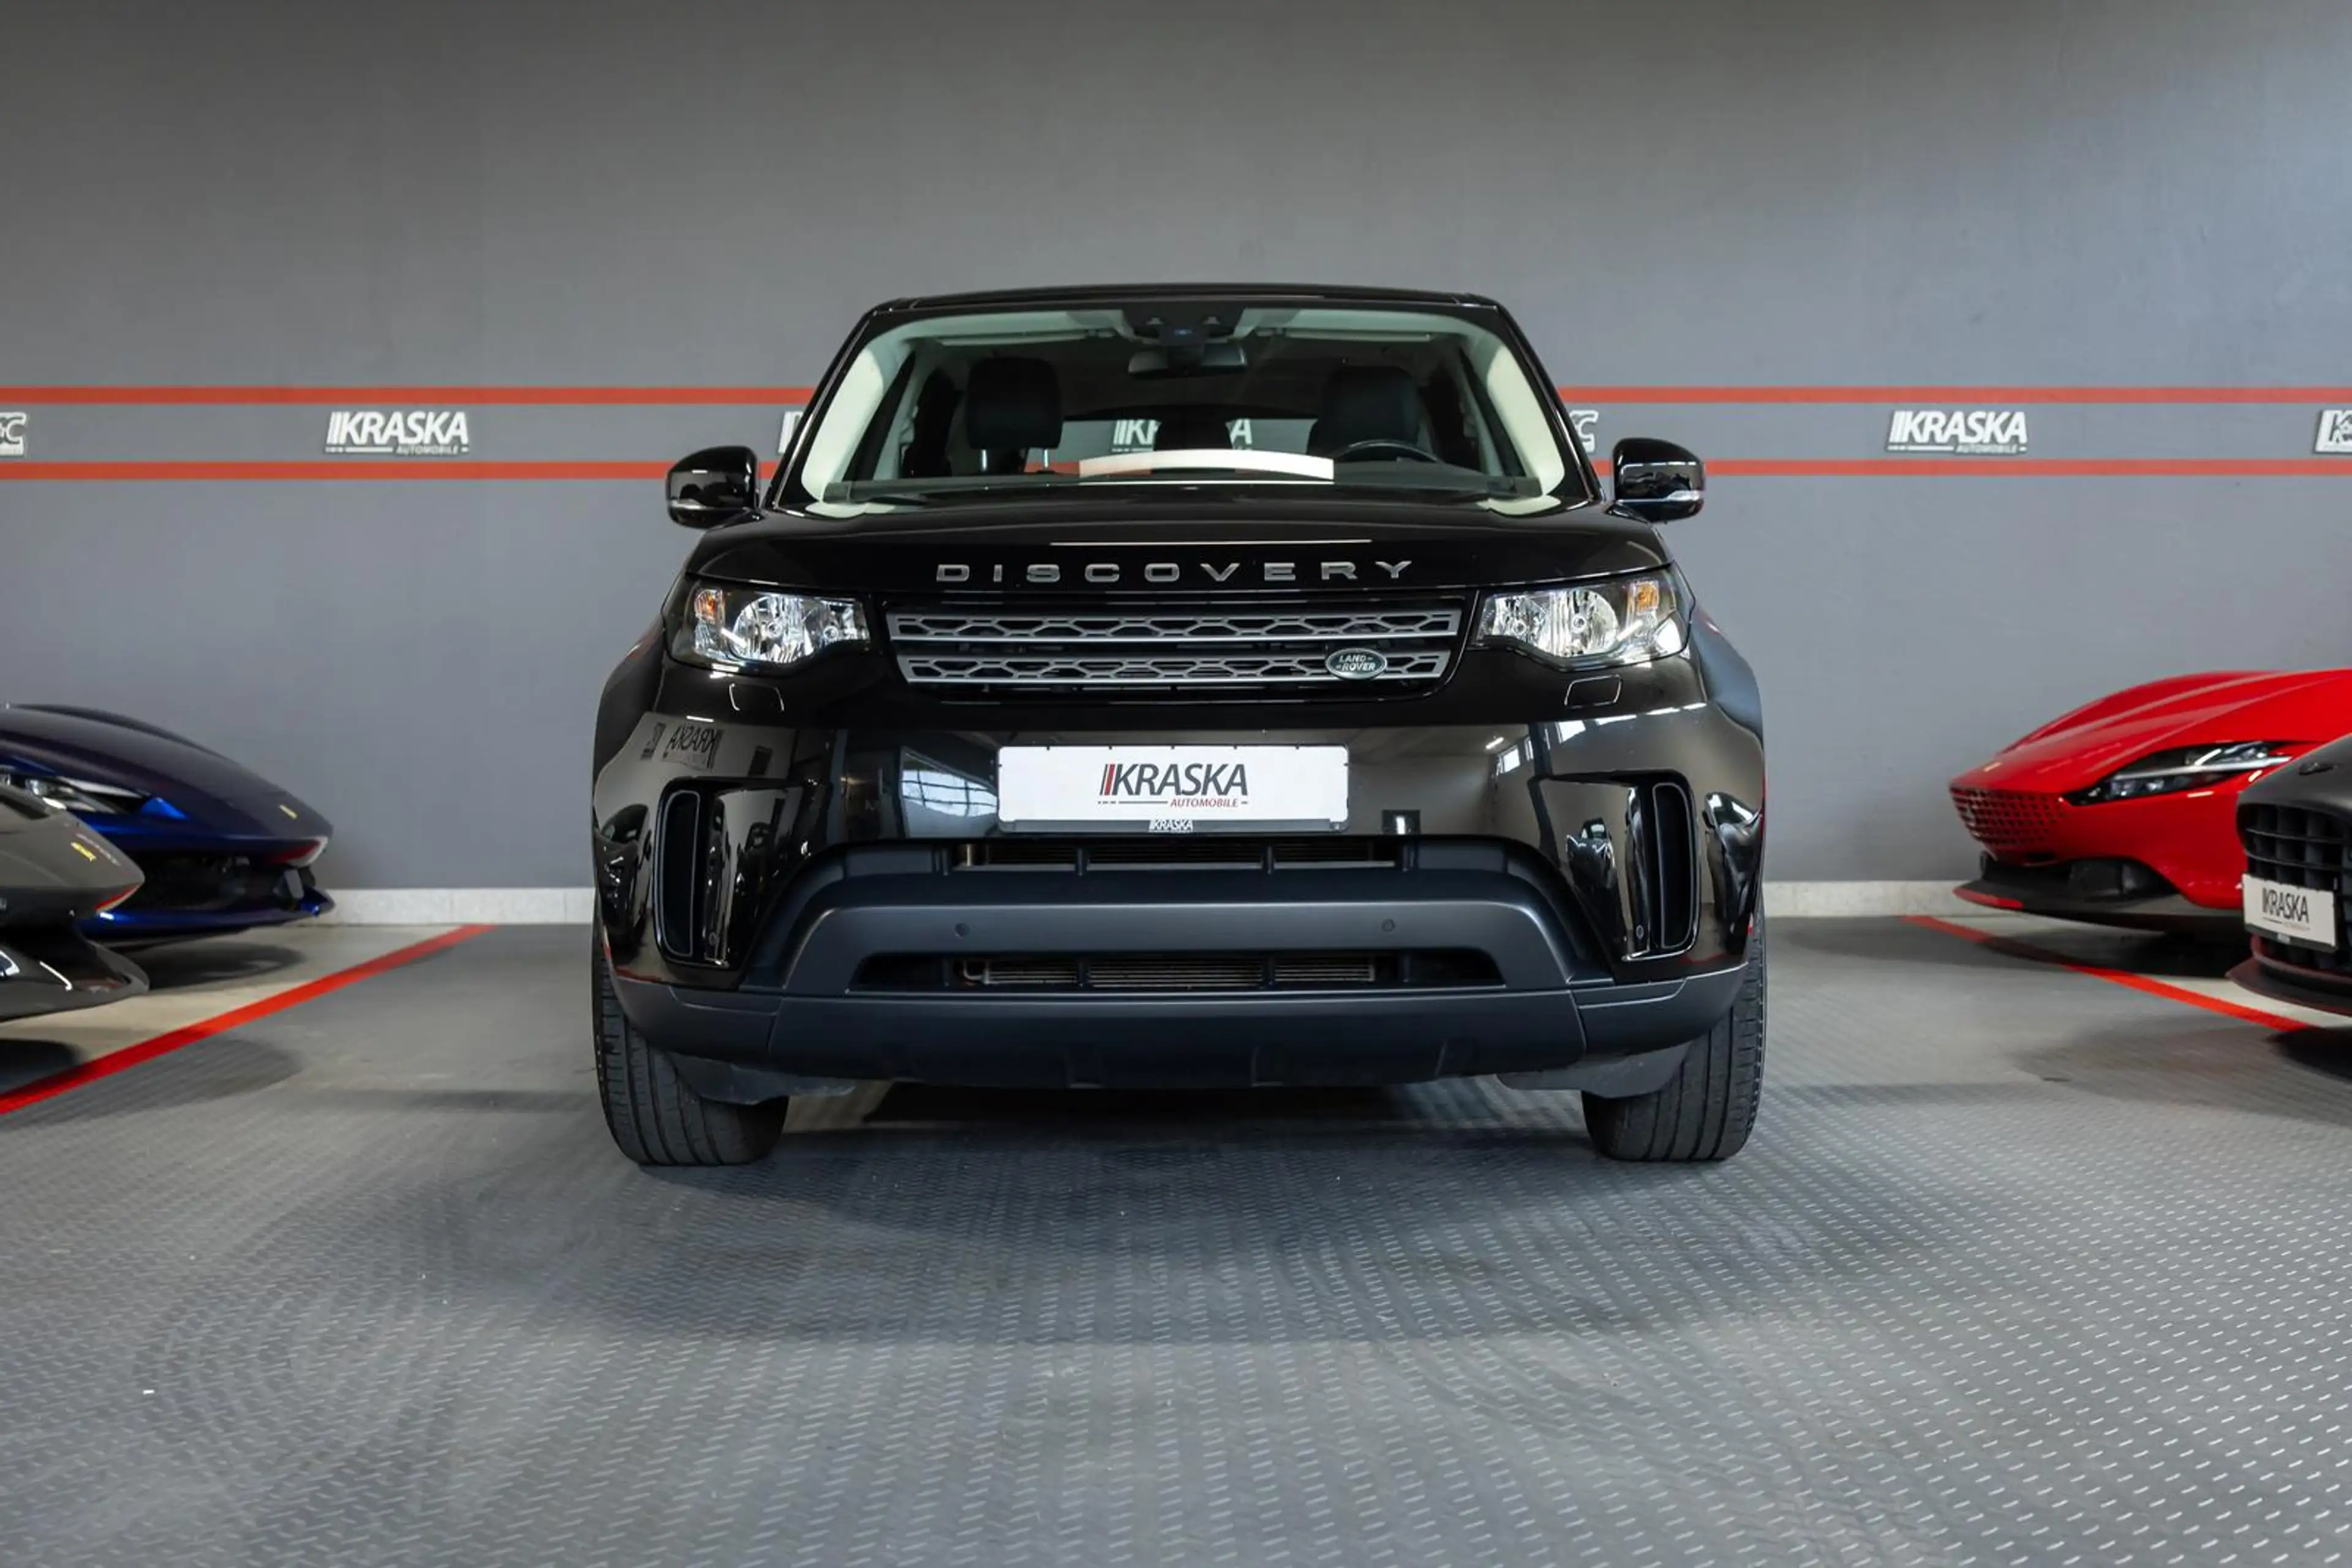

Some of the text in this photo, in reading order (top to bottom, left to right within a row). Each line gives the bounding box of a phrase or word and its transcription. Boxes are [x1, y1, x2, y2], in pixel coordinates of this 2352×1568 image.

[337, 411, 469, 444] KRASKA
[1900, 410, 2027, 443] KRASKA
[937, 560, 1412, 582] DISCOVERY
[1110, 763, 1248, 796] KRASKA
[1170, 797, 1238, 808] AUTOMOBILE
[1151, 819, 1194, 831] KRASKA
[2264, 888, 2309, 924] KRASKA
